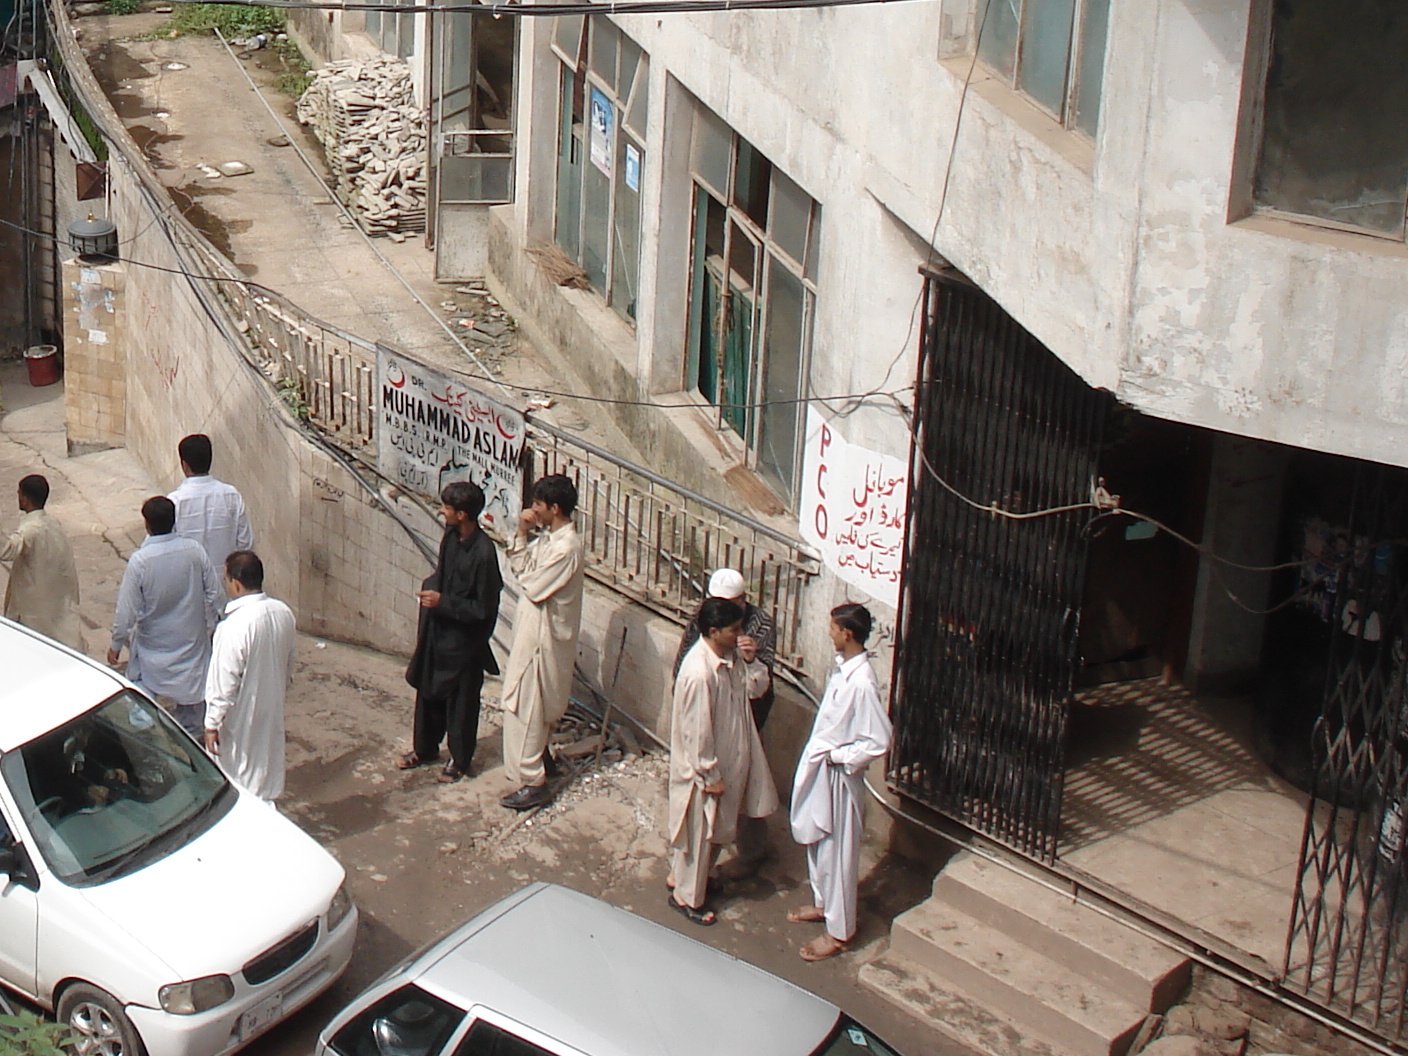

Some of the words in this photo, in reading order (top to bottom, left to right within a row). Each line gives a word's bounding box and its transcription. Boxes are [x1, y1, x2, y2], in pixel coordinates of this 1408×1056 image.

[383, 385, 471, 444] MUHAMMAD
[458, 445, 471, 460] THE
[472, 452, 489, 471] MALL
